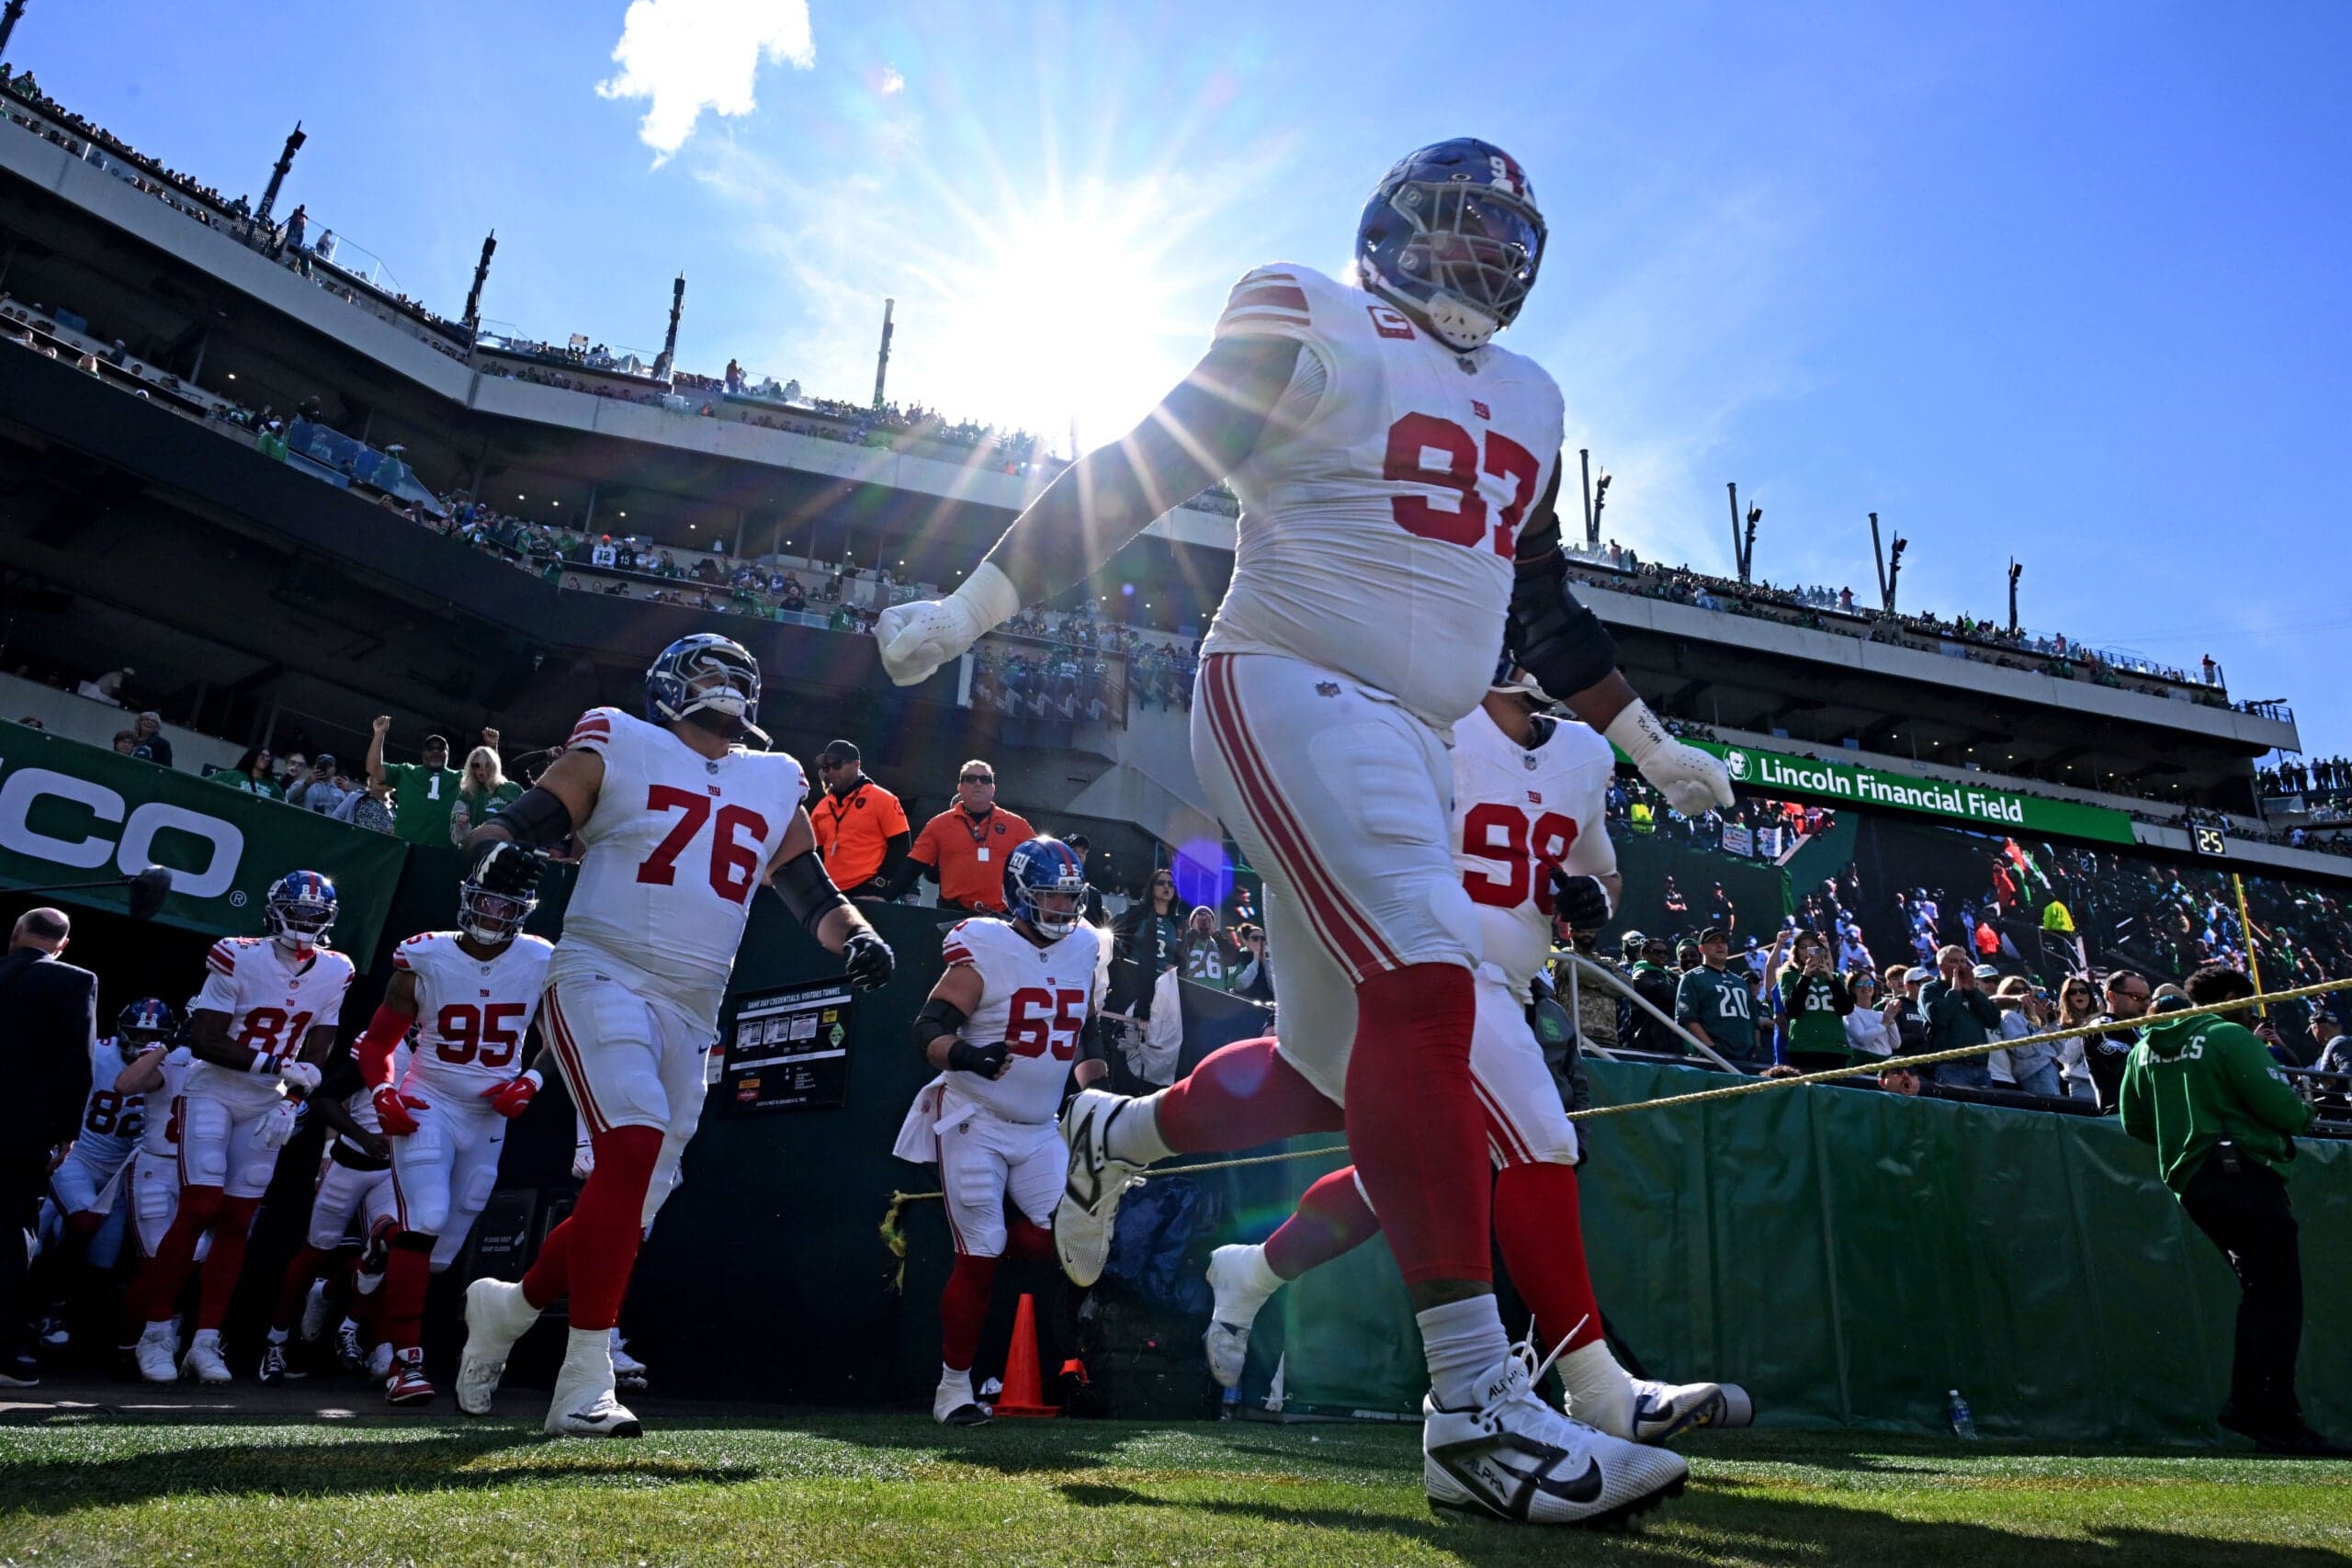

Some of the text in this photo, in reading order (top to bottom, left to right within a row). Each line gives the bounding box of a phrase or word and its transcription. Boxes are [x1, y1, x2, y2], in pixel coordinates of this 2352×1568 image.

[1384, 412, 1542, 561] 97
[599, 551, 611, 560] 12
[426, 775, 441, 801] 1
[1760, 757, 2024, 824] Lincoln Financial Field
[637, 784, 769, 905] 76
[1463, 803, 1578, 916] 98
[2199, 829, 2223, 853] 25
[302, 884, 322, 897] 81
[1189, 950, 1222, 979] 26
[1715, 985, 1750, 1021] 20
[1804, 985, 1836, 1012] 62
[236, 1007, 313, 1058] 81
[436, 1003, 526, 1067] 95
[1011, 987, 1085, 1061] 65
[86, 1089, 146, 1138] 82
